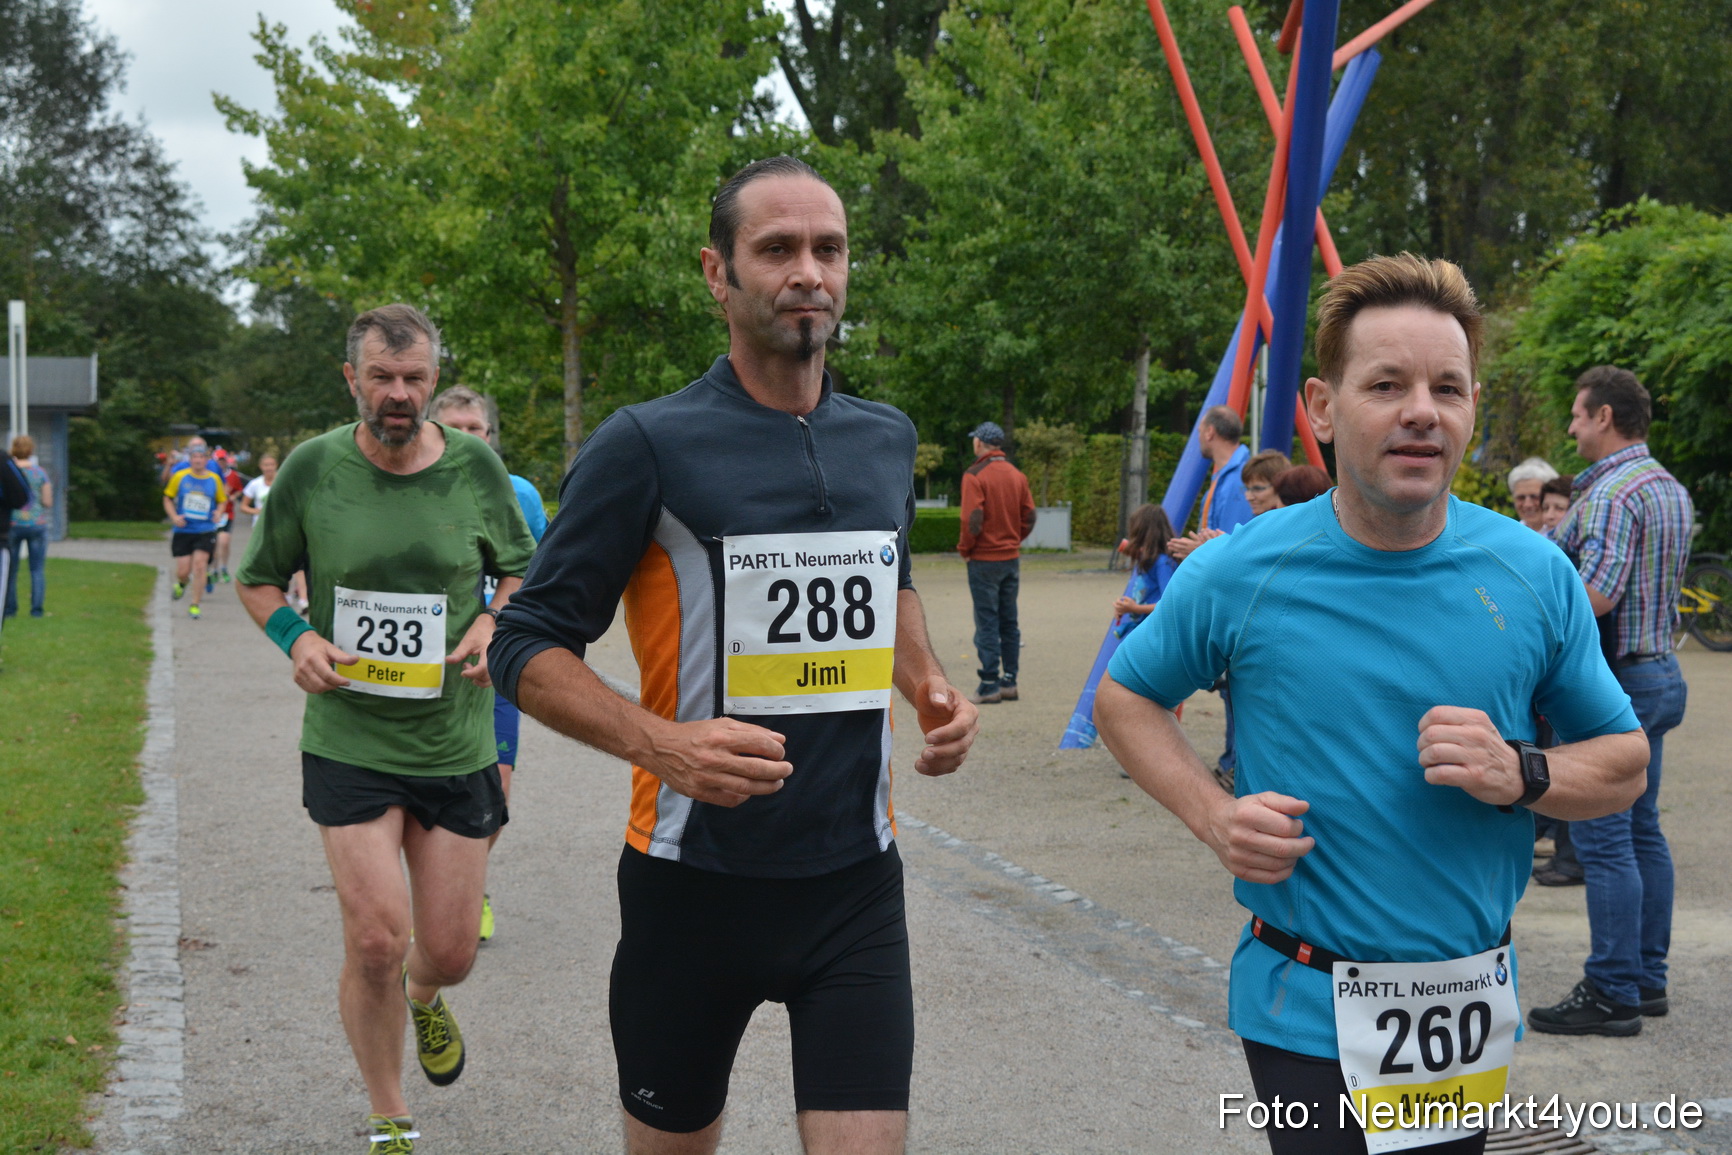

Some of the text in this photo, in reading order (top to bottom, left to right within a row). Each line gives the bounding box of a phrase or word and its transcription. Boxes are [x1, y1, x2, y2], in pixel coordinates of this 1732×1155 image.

[729, 550, 874, 570] PARTL Neumarkt
[337, 597, 427, 614] PARTL Neumarkt
[767, 575, 876, 644] 288
[356, 616, 423, 657] 233
[732, 643, 740, 653] D
[367, 664, 405, 682] Peter
[796, 660, 847, 687] Jimi
[1338, 973, 1492, 998] PARTL Neumarkt
[1376, 1000, 1492, 1075] 260
[1350, 1075, 1358, 1087] D
